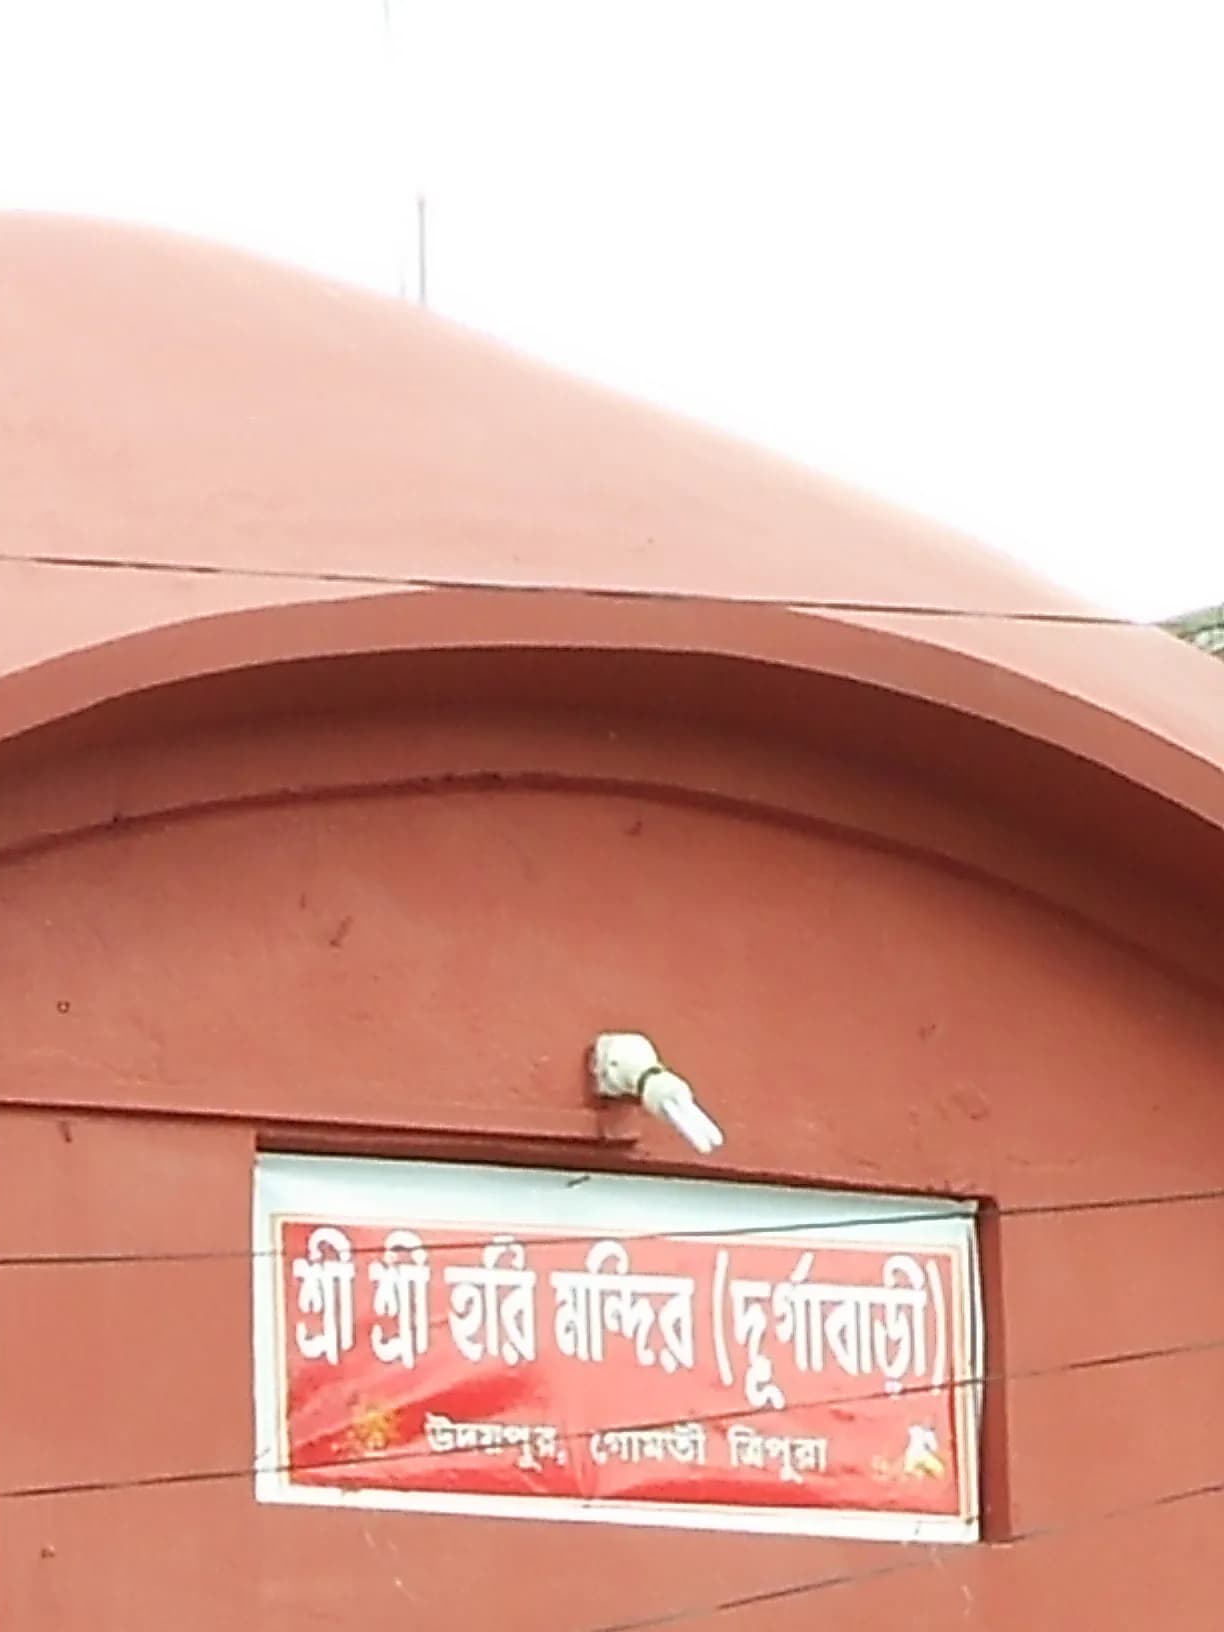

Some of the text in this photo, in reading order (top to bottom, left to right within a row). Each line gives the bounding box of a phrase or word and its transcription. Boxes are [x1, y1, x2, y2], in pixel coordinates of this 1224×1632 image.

[292, 1228, 356, 1366] শ্রী
[368, 1229, 431, 1368] শ্রী
[444, 1234, 536, 1366] হরি
[550, 1239, 695, 1373] মন্দির
[589, 1422, 706, 1465] গোমতী
[727, 1425, 828, 1483] ত্রিপুরা
